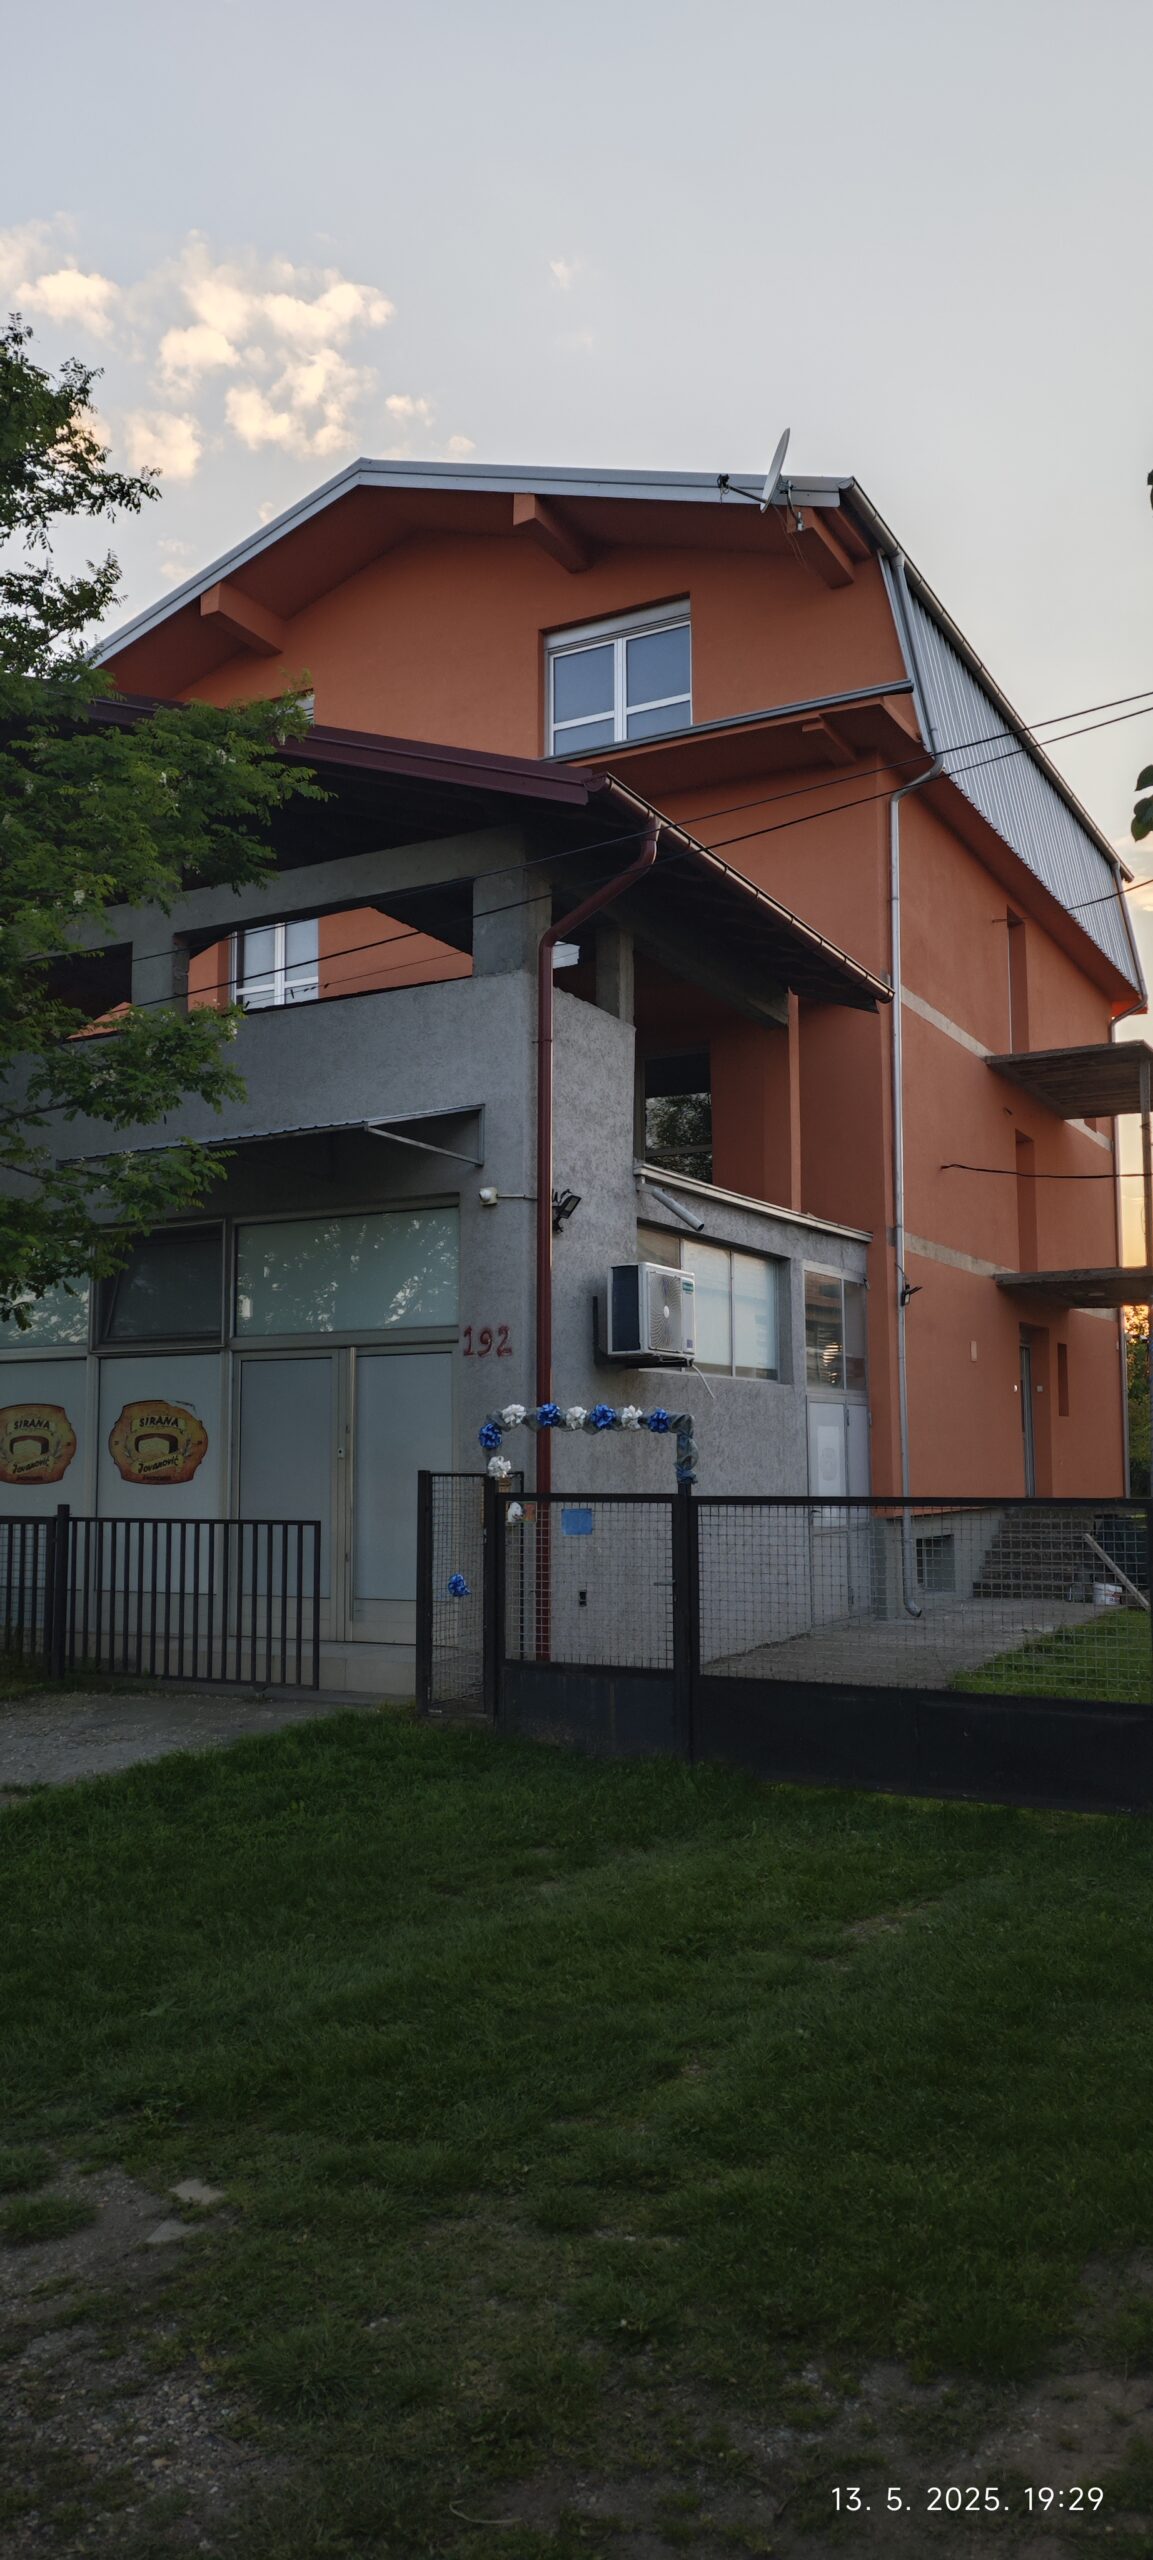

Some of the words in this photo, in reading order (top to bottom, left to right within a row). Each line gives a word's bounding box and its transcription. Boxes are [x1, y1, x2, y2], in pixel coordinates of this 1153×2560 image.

[463, 1325, 512, 1358] 192
[14, 1419, 50, 1430] SIRANA
[139, 1416, 179, 1428] SIRANA
